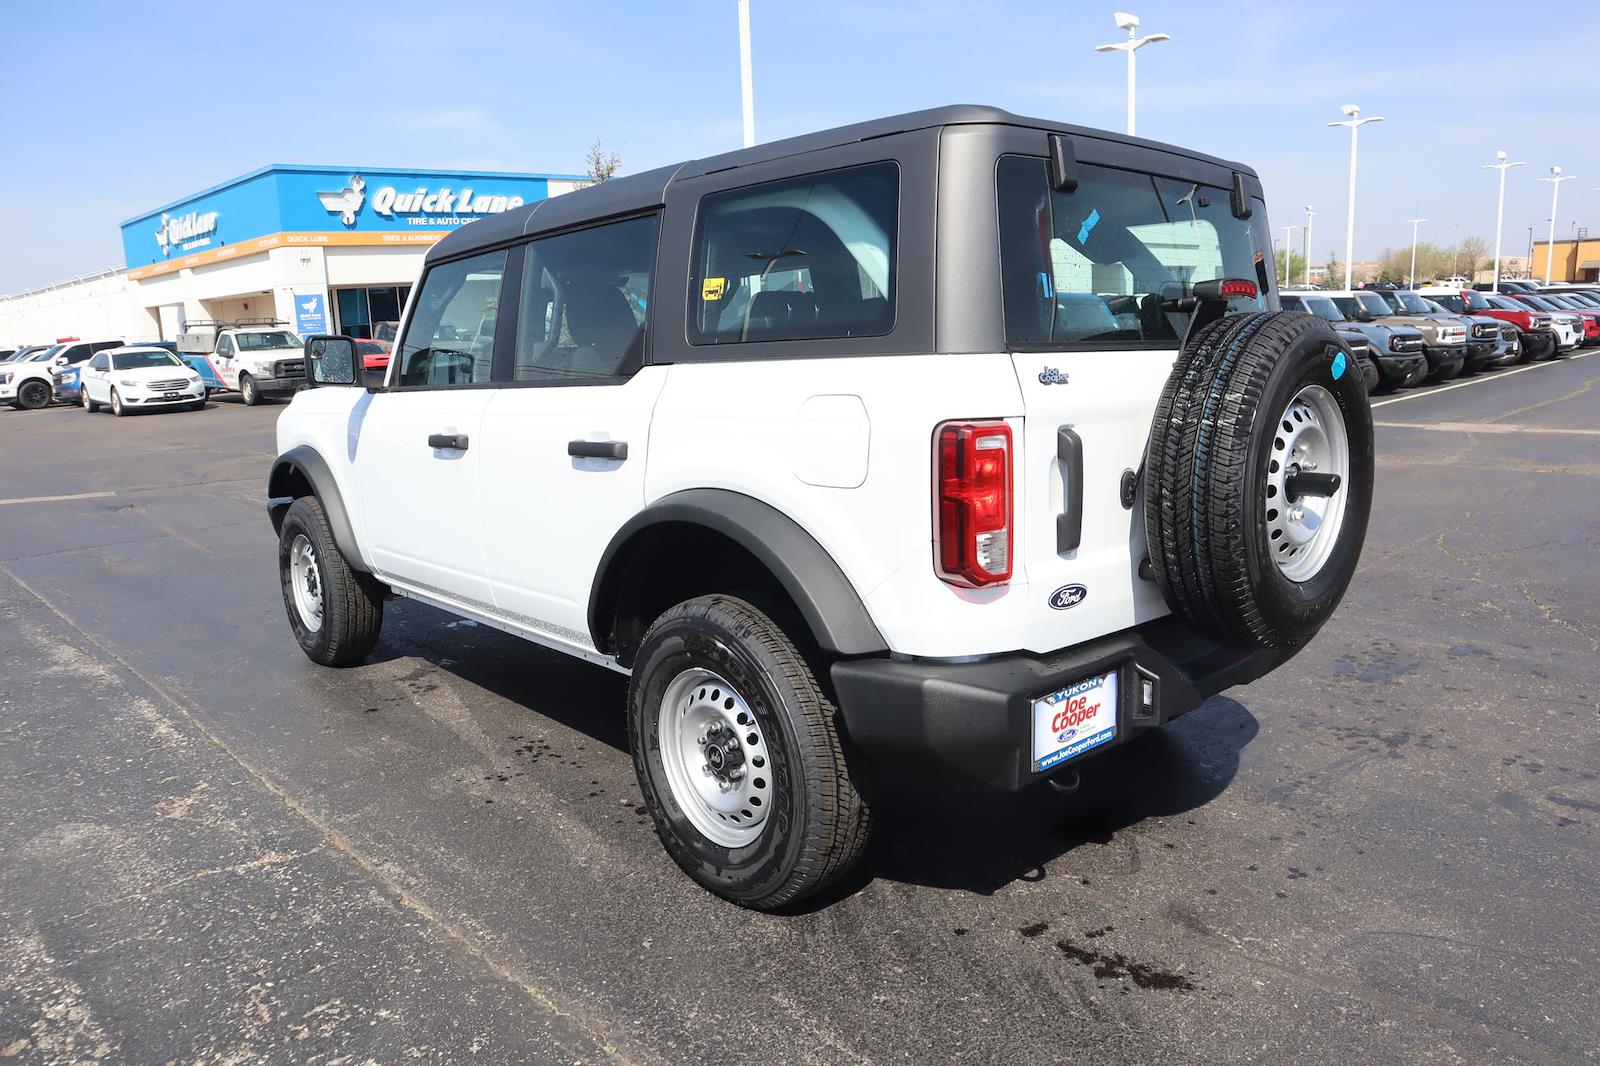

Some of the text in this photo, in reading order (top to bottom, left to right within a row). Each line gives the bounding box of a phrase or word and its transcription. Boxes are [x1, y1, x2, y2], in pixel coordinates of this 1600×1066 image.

[373, 187, 524, 216] Quick Lane
[407, 217, 427, 225] TIRE
[429, 217, 435, 225] &
[436, 217, 459, 225] AUTO
[1057, 588, 1082, 606] Ford
[1057, 679, 1097, 699] YUKON
[1062, 696, 1087, 716] Joe
[1052, 703, 1101, 733] Cooper
